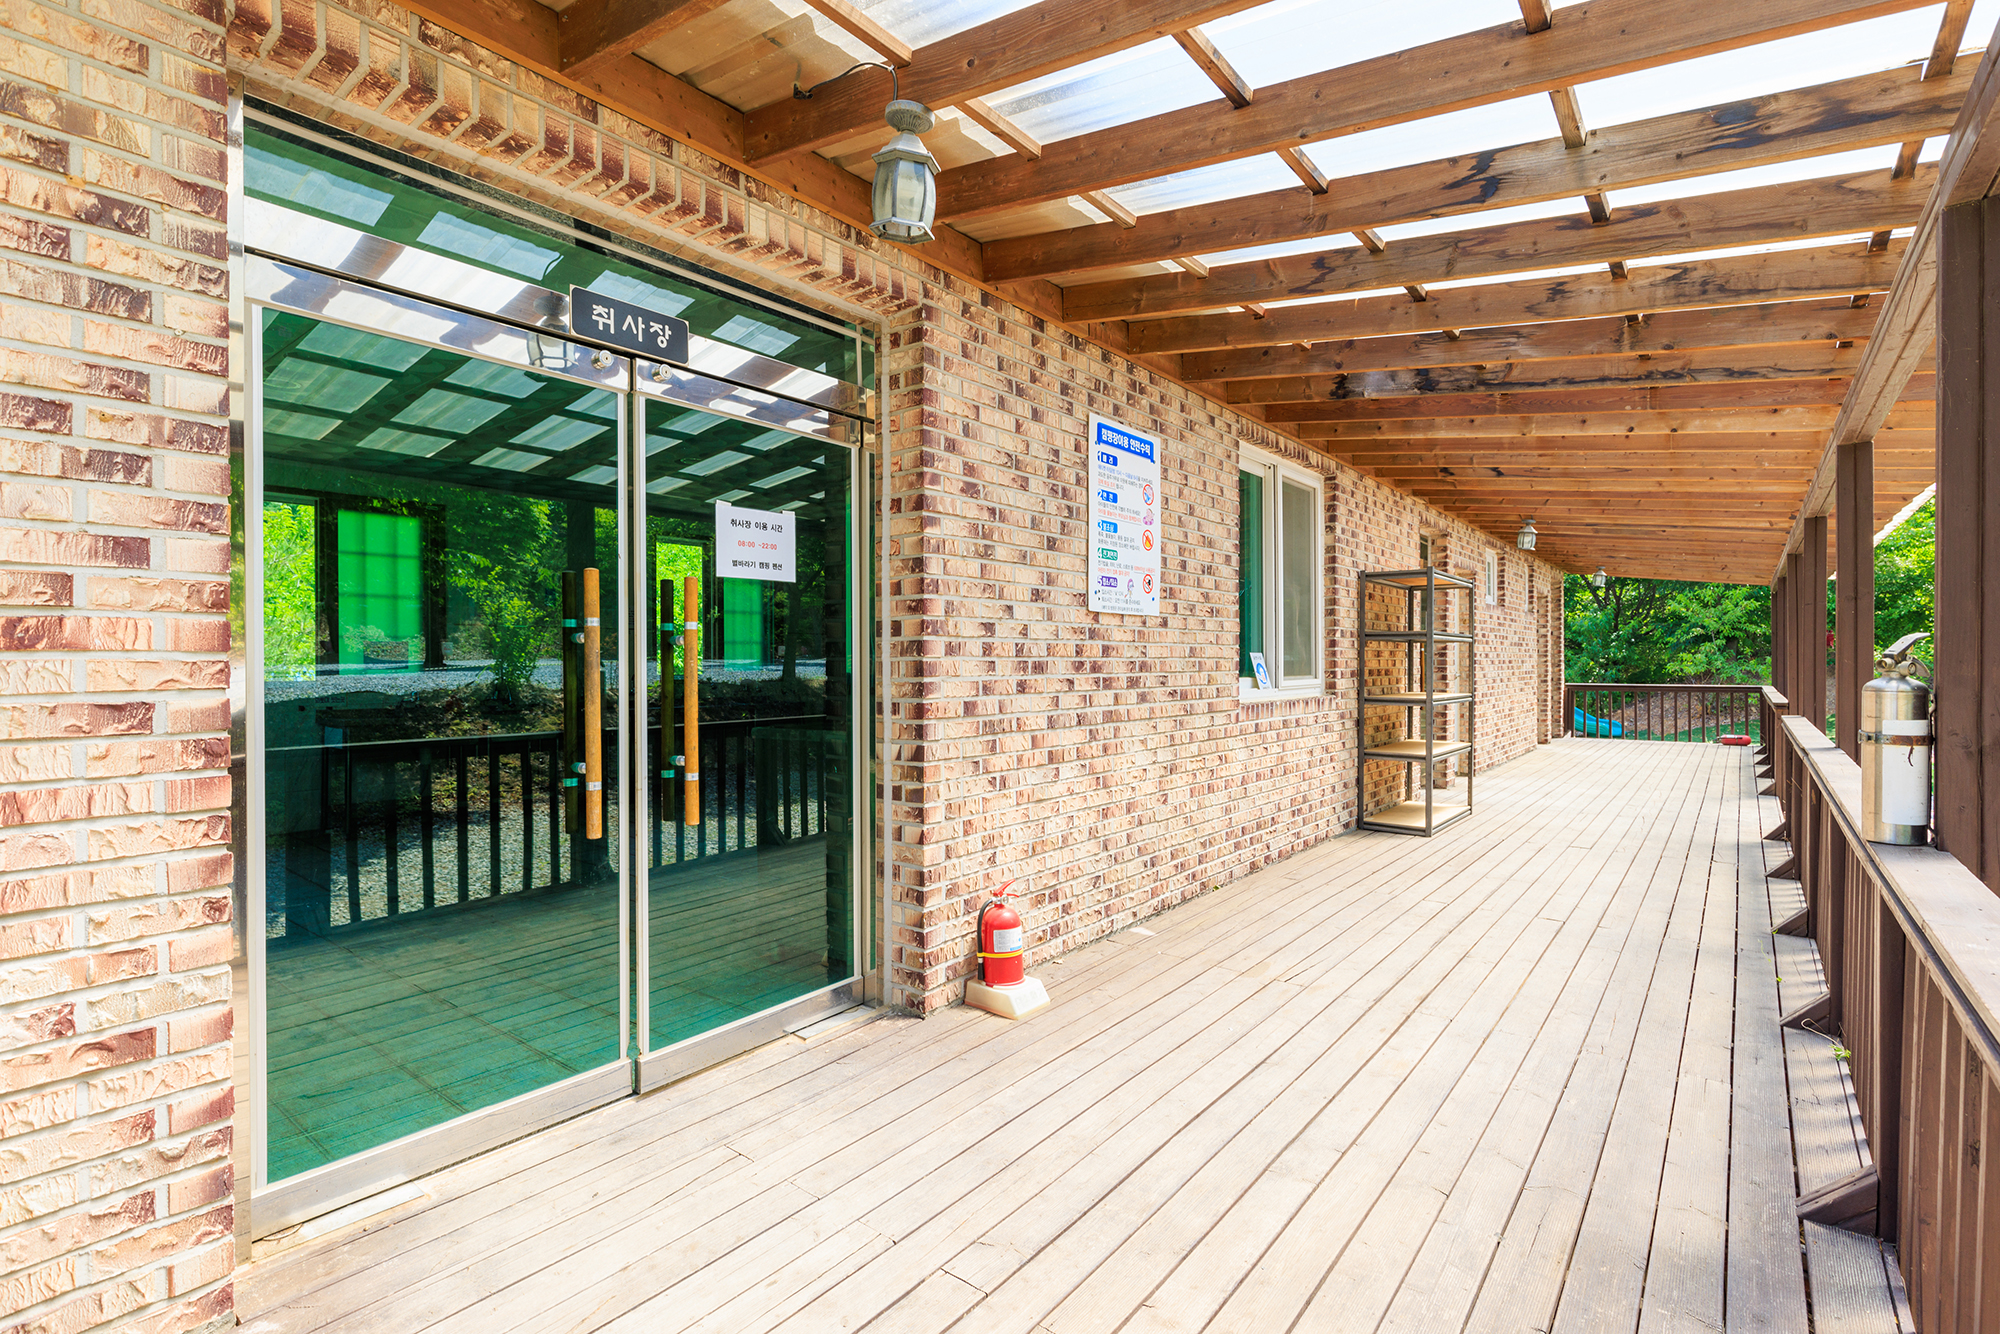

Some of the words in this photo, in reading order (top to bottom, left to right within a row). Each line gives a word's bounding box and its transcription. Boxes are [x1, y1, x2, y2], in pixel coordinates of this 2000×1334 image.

[592, 304, 672, 348] 취사장
[731, 518, 751, 529] 취사장
[755, 521, 768, 531] 이용
[771, 524, 783, 533] 시간
[738, 540, 755, 548] 08:00
[772, 562, 783, 571] 펜션
